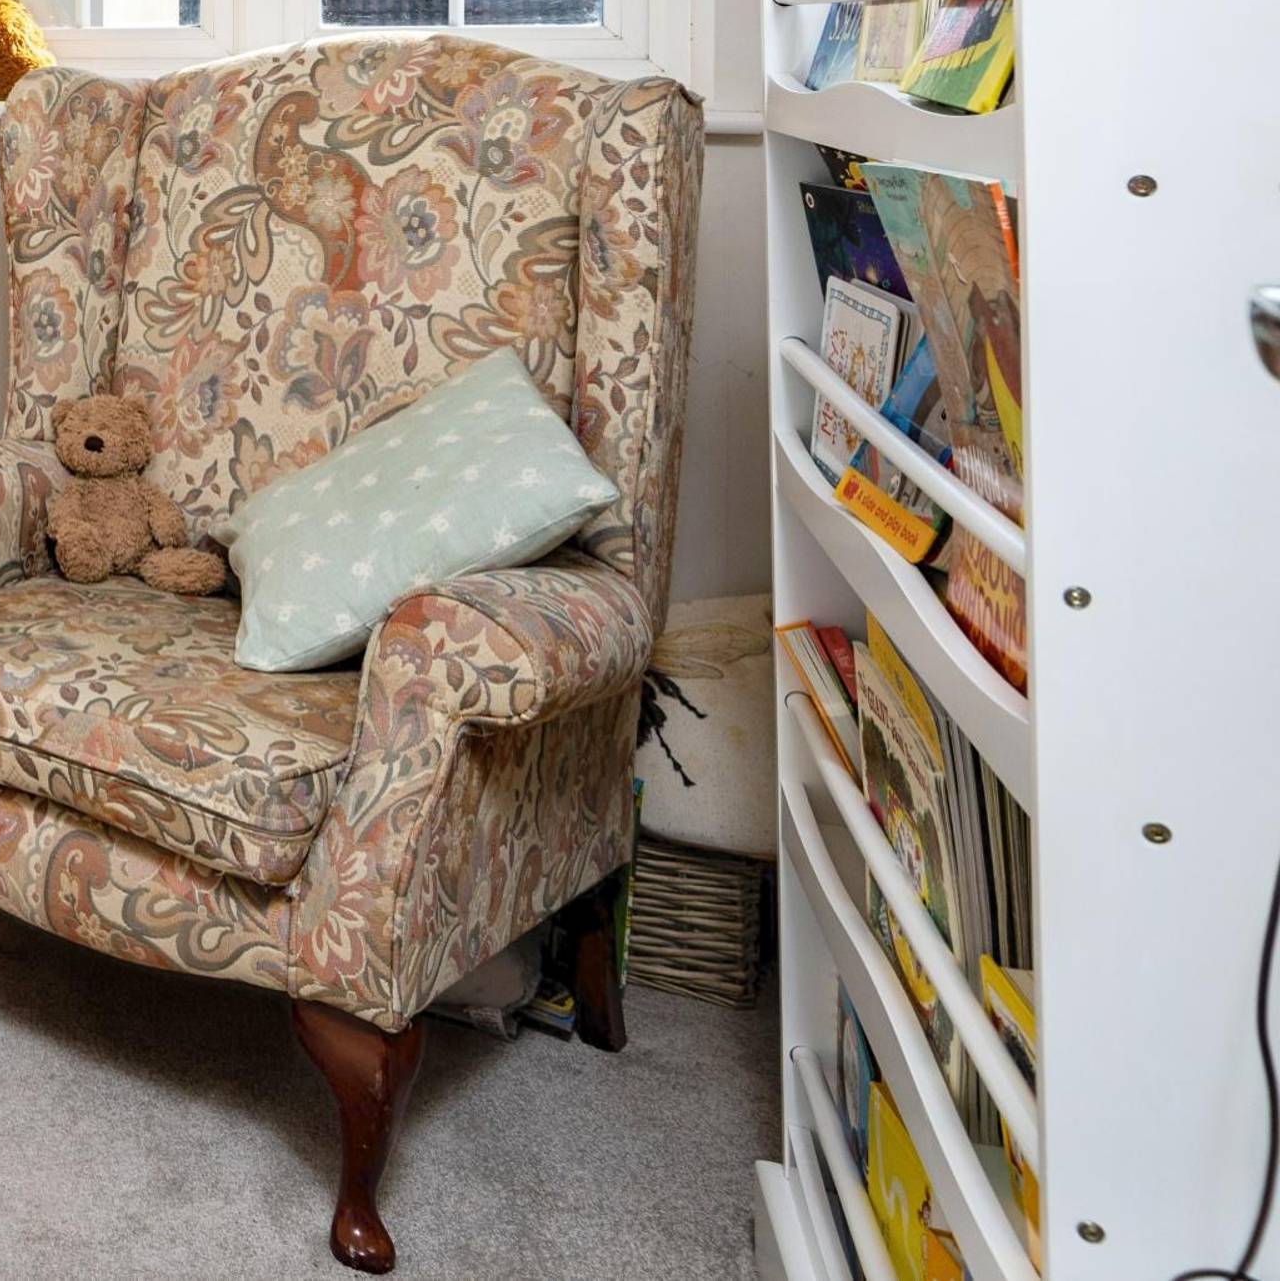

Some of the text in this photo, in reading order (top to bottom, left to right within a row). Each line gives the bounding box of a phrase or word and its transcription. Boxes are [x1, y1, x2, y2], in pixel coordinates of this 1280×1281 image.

[862, 493, 876, 513] slide
[875, 506, 890, 522] and
[885, 515, 901, 536] play
[900, 523, 920, 546] book
